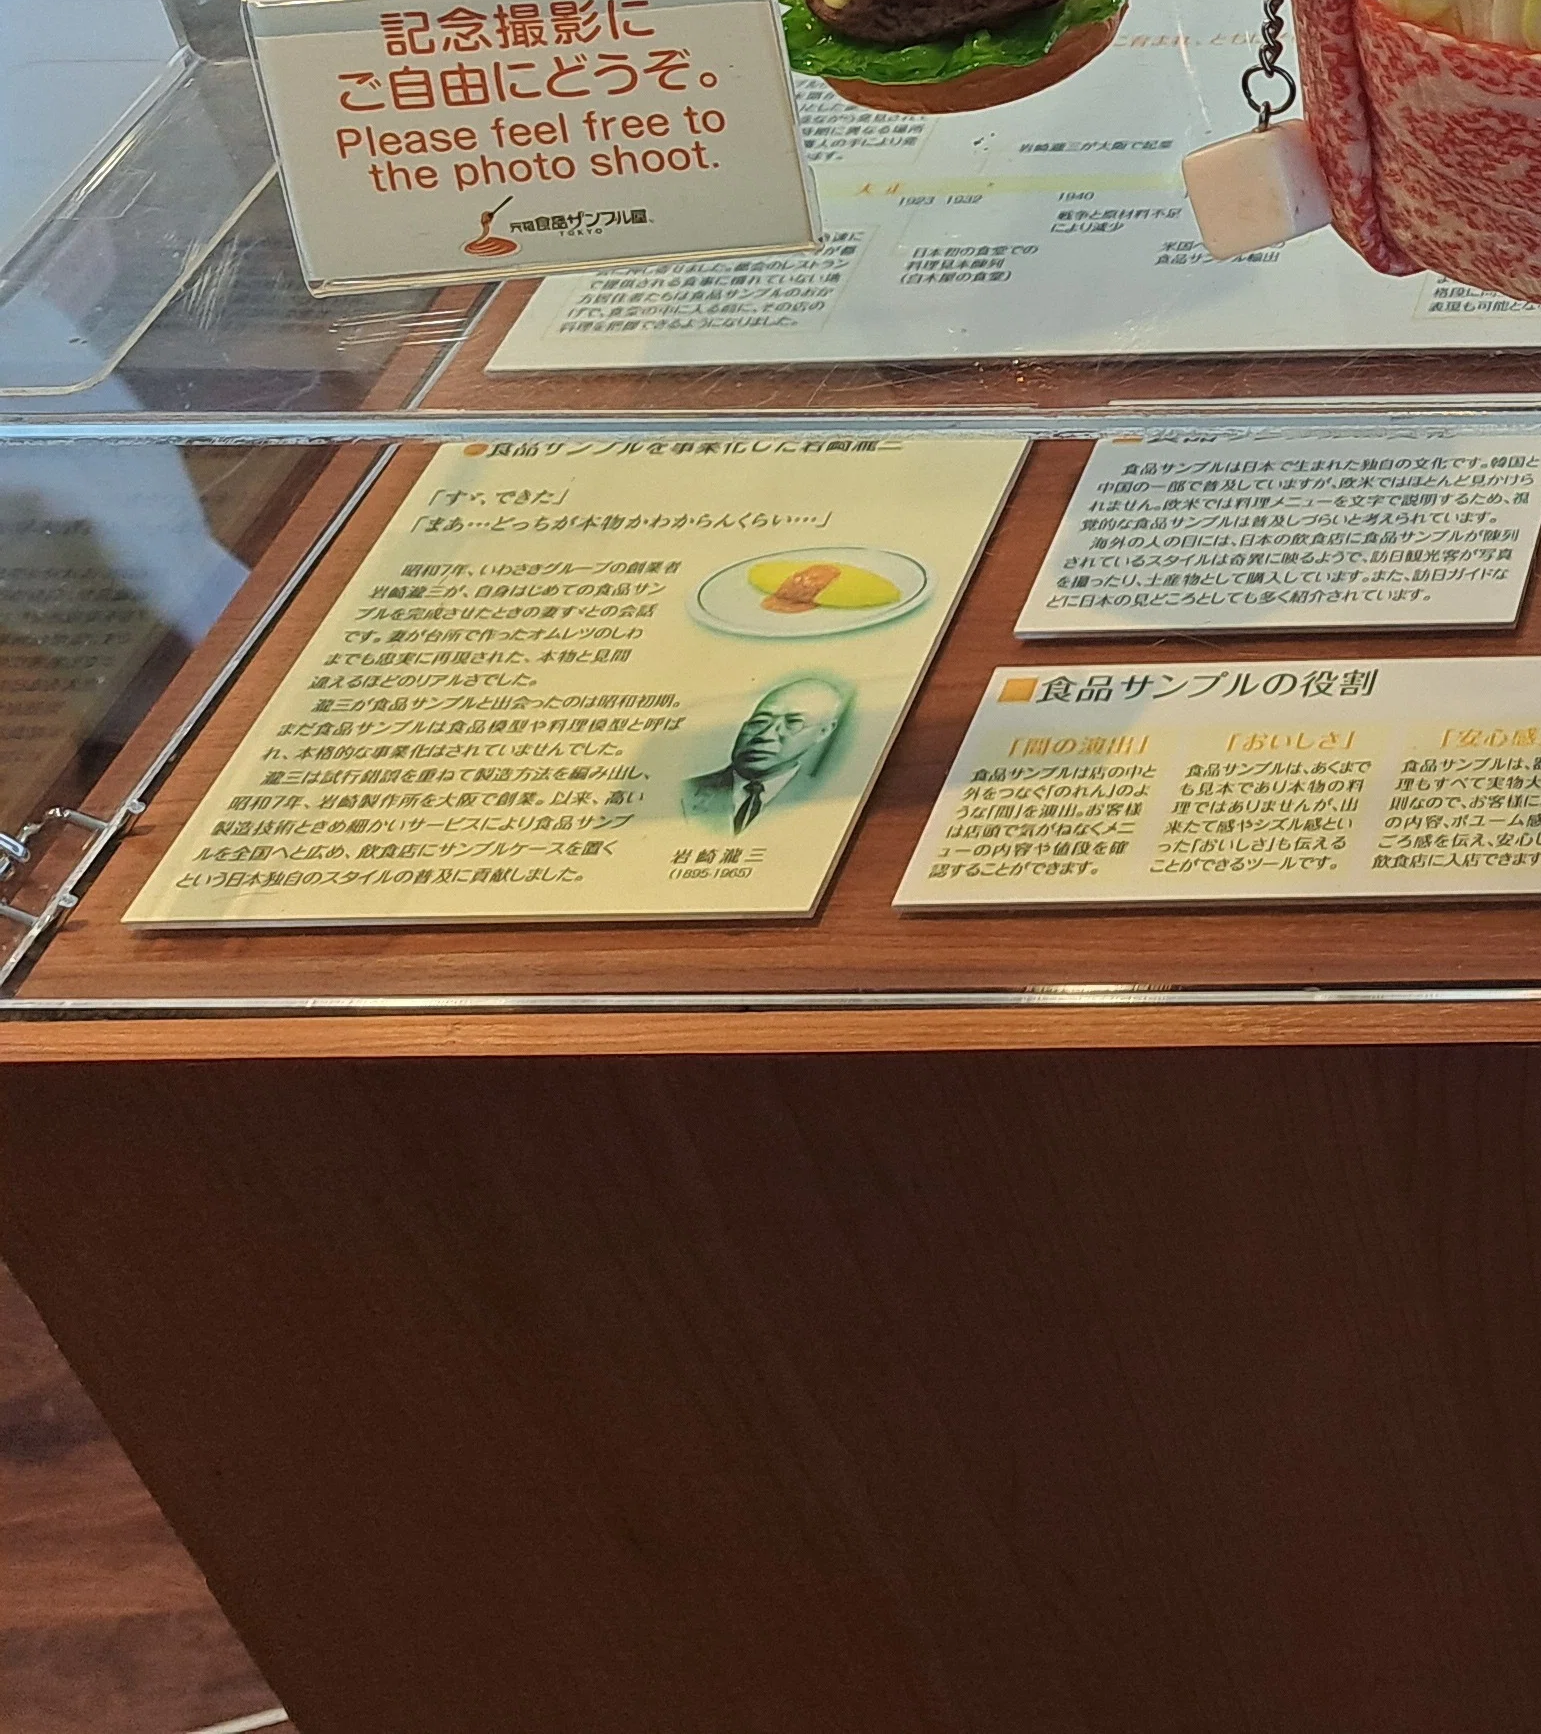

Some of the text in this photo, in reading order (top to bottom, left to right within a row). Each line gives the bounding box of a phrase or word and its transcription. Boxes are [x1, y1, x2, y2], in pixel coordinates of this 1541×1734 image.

[337, 49, 720, 112] ご自由にどうぞ。
[336, 106, 727, 160] Please feel free to
[368, 141, 717, 192] the photo shoot.
[1058, 192, 1095, 202] 1940
[1050, 221, 1125, 234] により減少
[1035, 668, 1378, 704] 食品サンプルの役割
[1227, 731, 1355, 753] 「おいしさ」
[970, 765, 1157, 782] 食品サンプルは店の中と
[1185, 761, 1372, 778] 食品サンプルは、あくまで
[962, 784, 1149, 801] 外をつなぐ「のれん」のよ
[1181, 779, 1365, 796] も見本であり本物の料
[1172, 797, 1359, 815] 理ではありませんが、出
[946, 821, 1136, 839] は店頭で気がねなくメニ
[1163, 816, 1352, 834] 来たて感やシズル感とい
[1158, 836, 1347, 853] った「おいしさ」も伝える
[928, 861, 1099, 878] 認することができます。
[1150, 855, 1338, 872] ことができるツールです。
